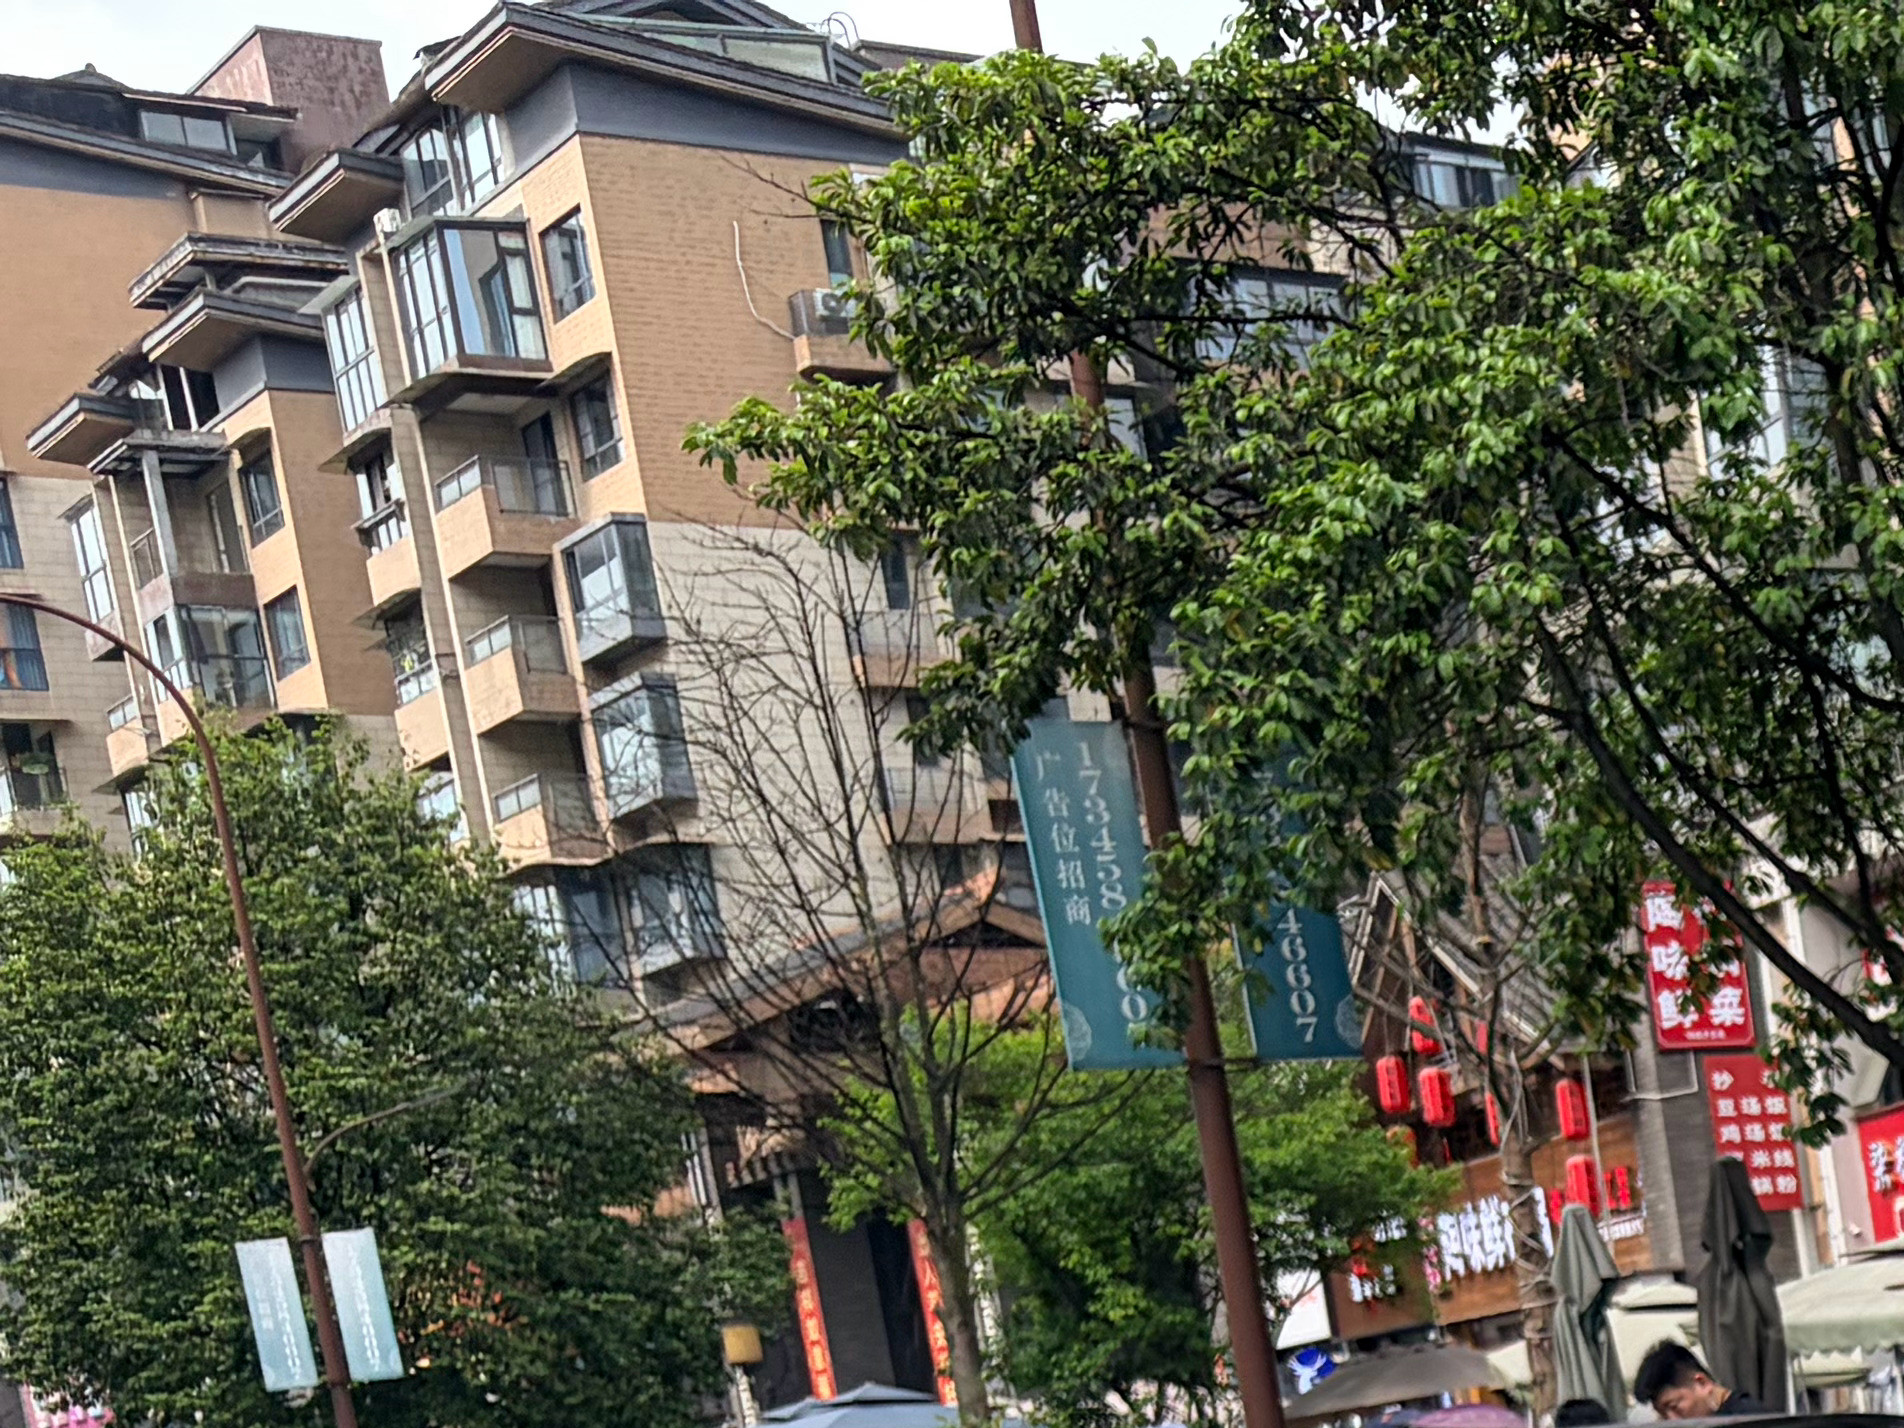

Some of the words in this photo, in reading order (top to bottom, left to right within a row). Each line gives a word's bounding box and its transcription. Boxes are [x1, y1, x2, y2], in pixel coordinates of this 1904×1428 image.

[1034, 750, 1092, 926] 广告位招商
